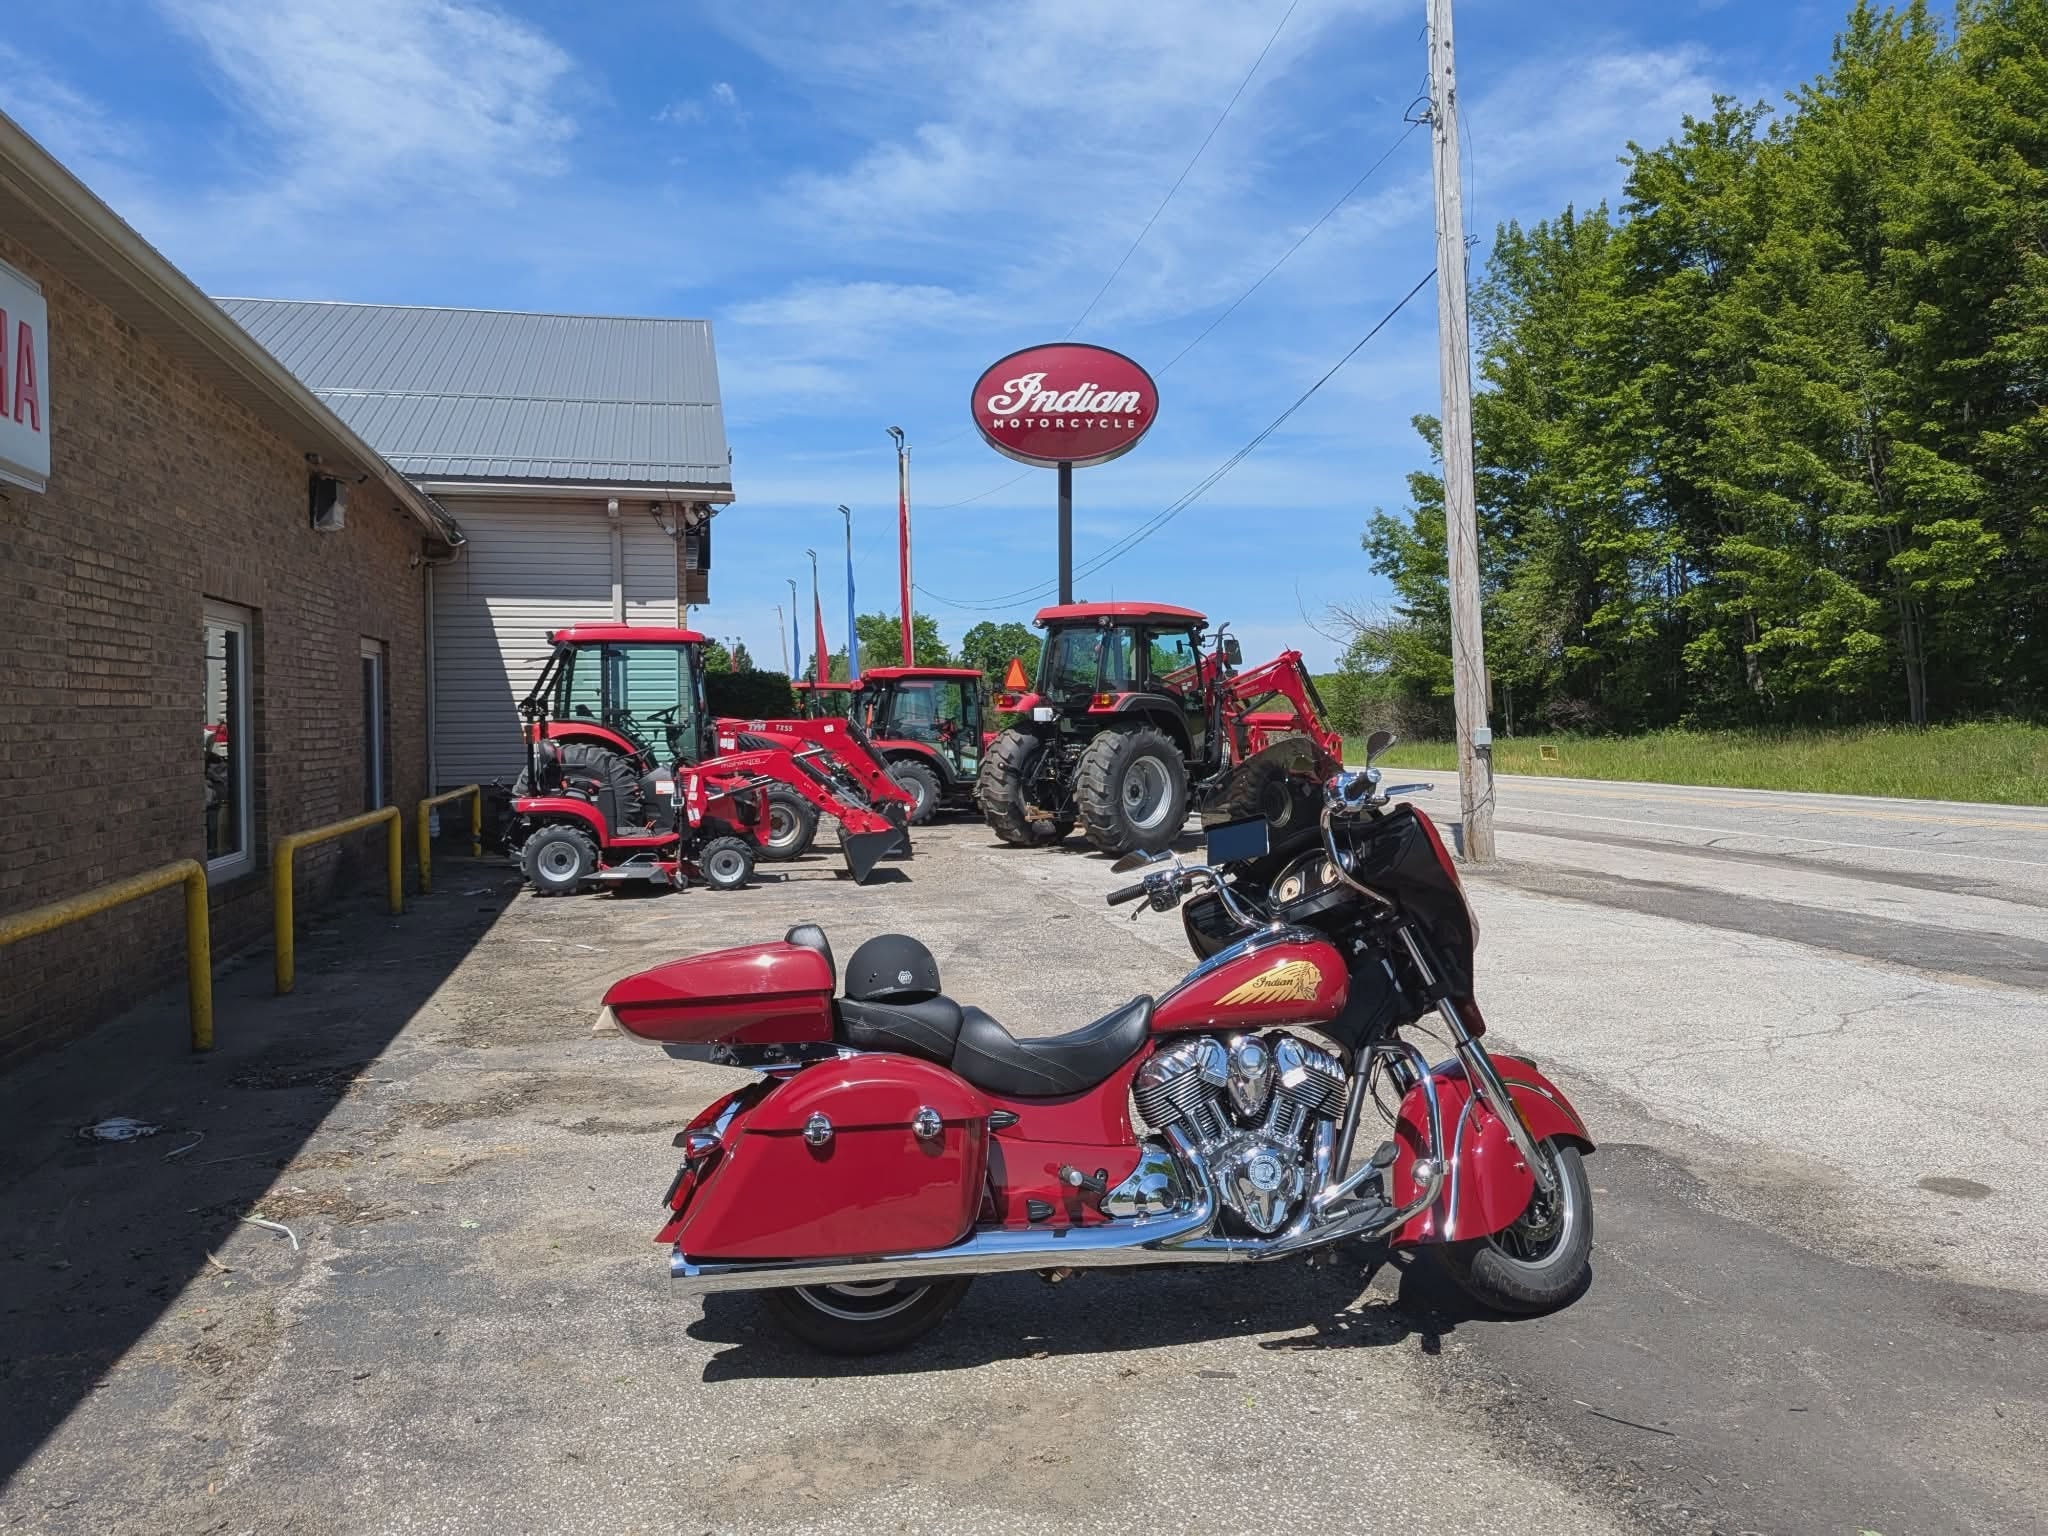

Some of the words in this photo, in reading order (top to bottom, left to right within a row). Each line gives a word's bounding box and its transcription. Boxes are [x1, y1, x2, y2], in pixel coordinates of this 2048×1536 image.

[987, 372, 1141, 415] Indian
[993, 418, 1135, 429] MOTORCYCLE
[1252, 976, 1294, 988] Indian
